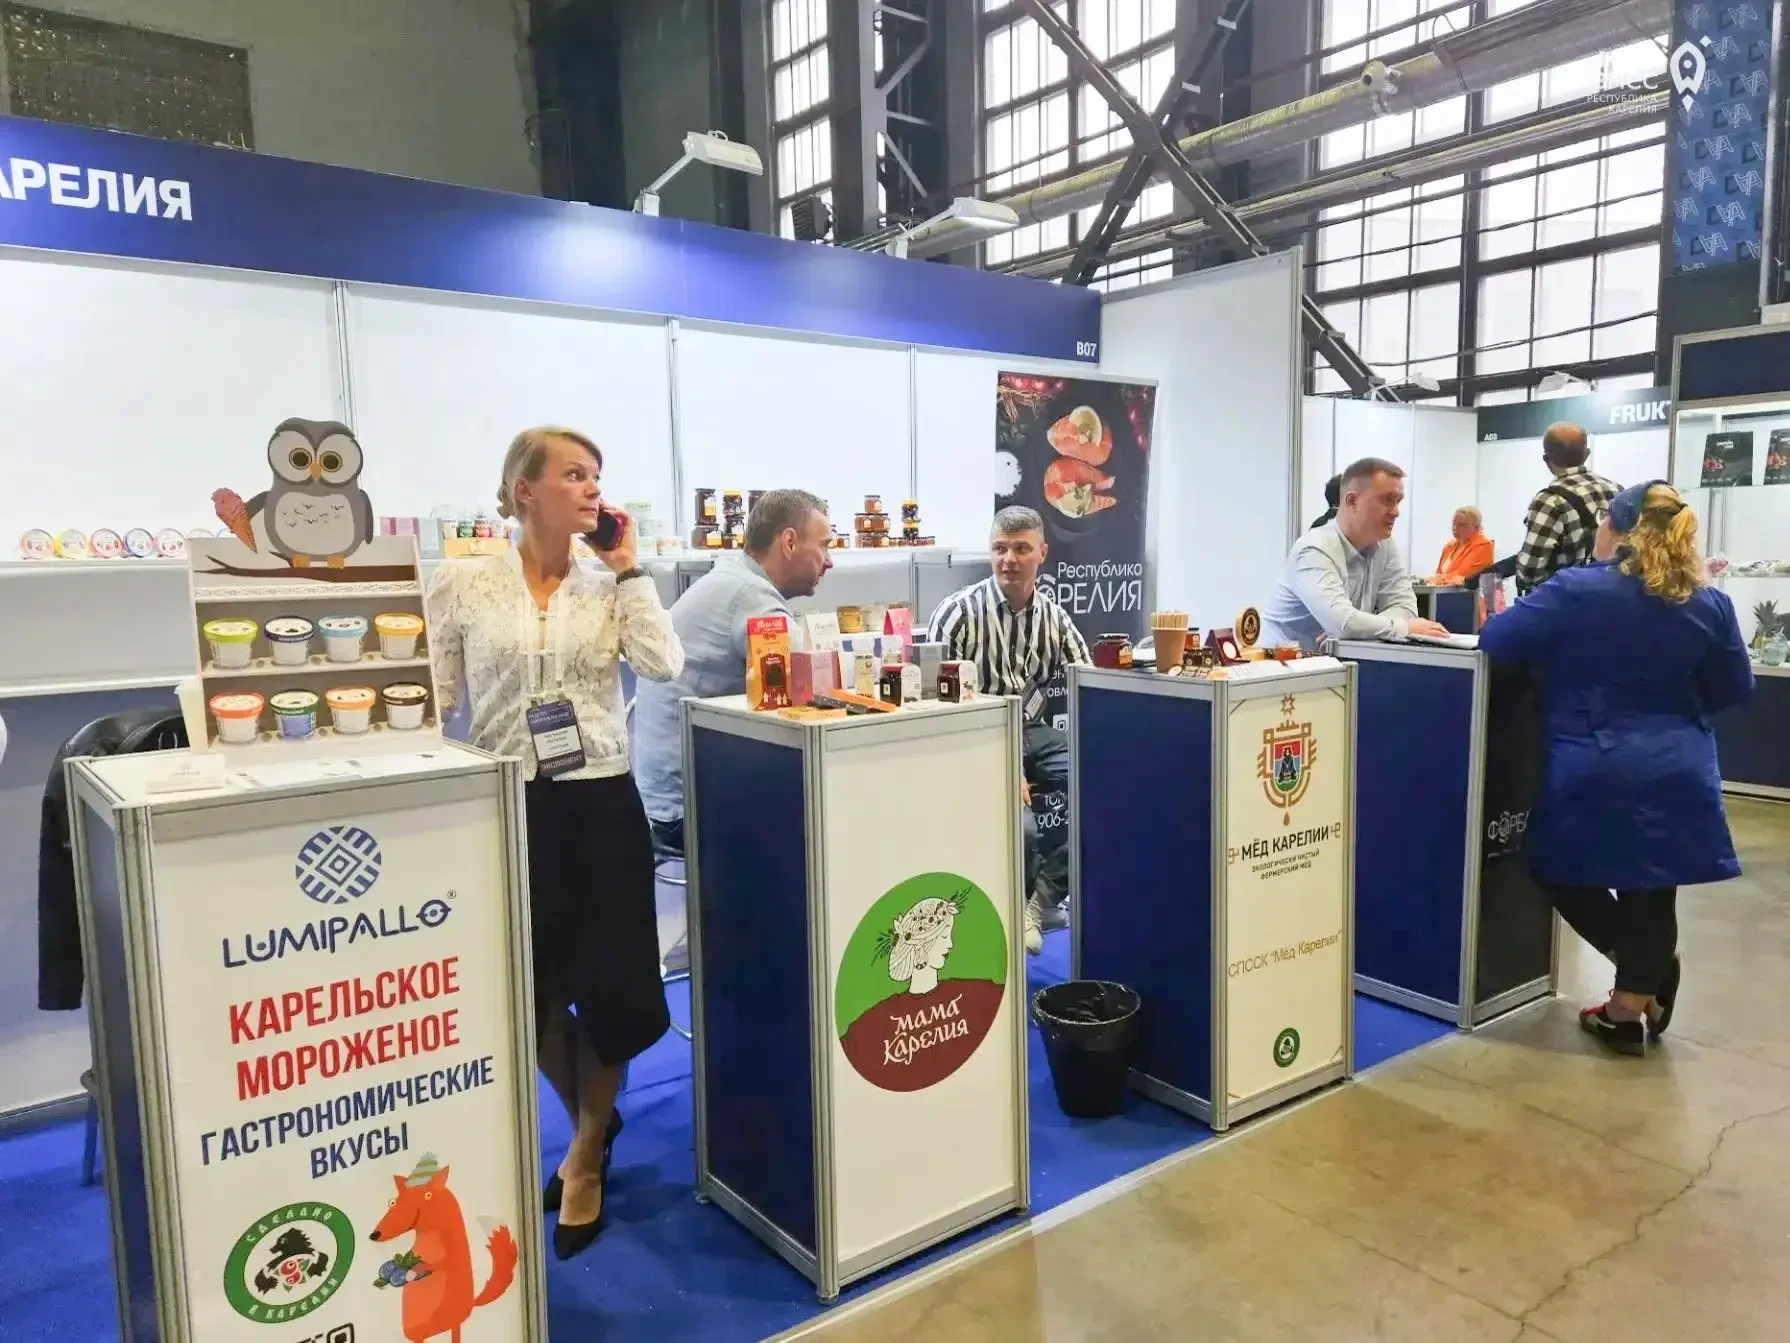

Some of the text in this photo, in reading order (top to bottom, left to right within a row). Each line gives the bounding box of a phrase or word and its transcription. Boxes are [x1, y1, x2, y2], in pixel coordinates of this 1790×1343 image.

[1076, 341, 1097, 357] B07
[1609, 401, 1672, 425] FRUK
[1241, 825, 1329, 861] МЁД КАРЕЛИИ
[1252, 855, 1297, 873] ЭКОЛОГИЧЕСКИ
[1260, 863, 1299, 880] ФЕРМЕРСКИЙ
[1227, 953, 1269, 978] СПССК
[229, 956, 460, 1045] КАРЕЛЬСКОЕ
[236, 1008, 460, 1101] МОРОЖЕНОЕ
[200, 1056, 495, 1166] ГАСТРОНОМИЧЕСКИЕ
[310, 1122, 409, 1180] ВКУСЫ
[245, 1206, 333, 1243] СДЕЛАНО
[265, 1277, 339, 1319] КАРЕЛИИ
